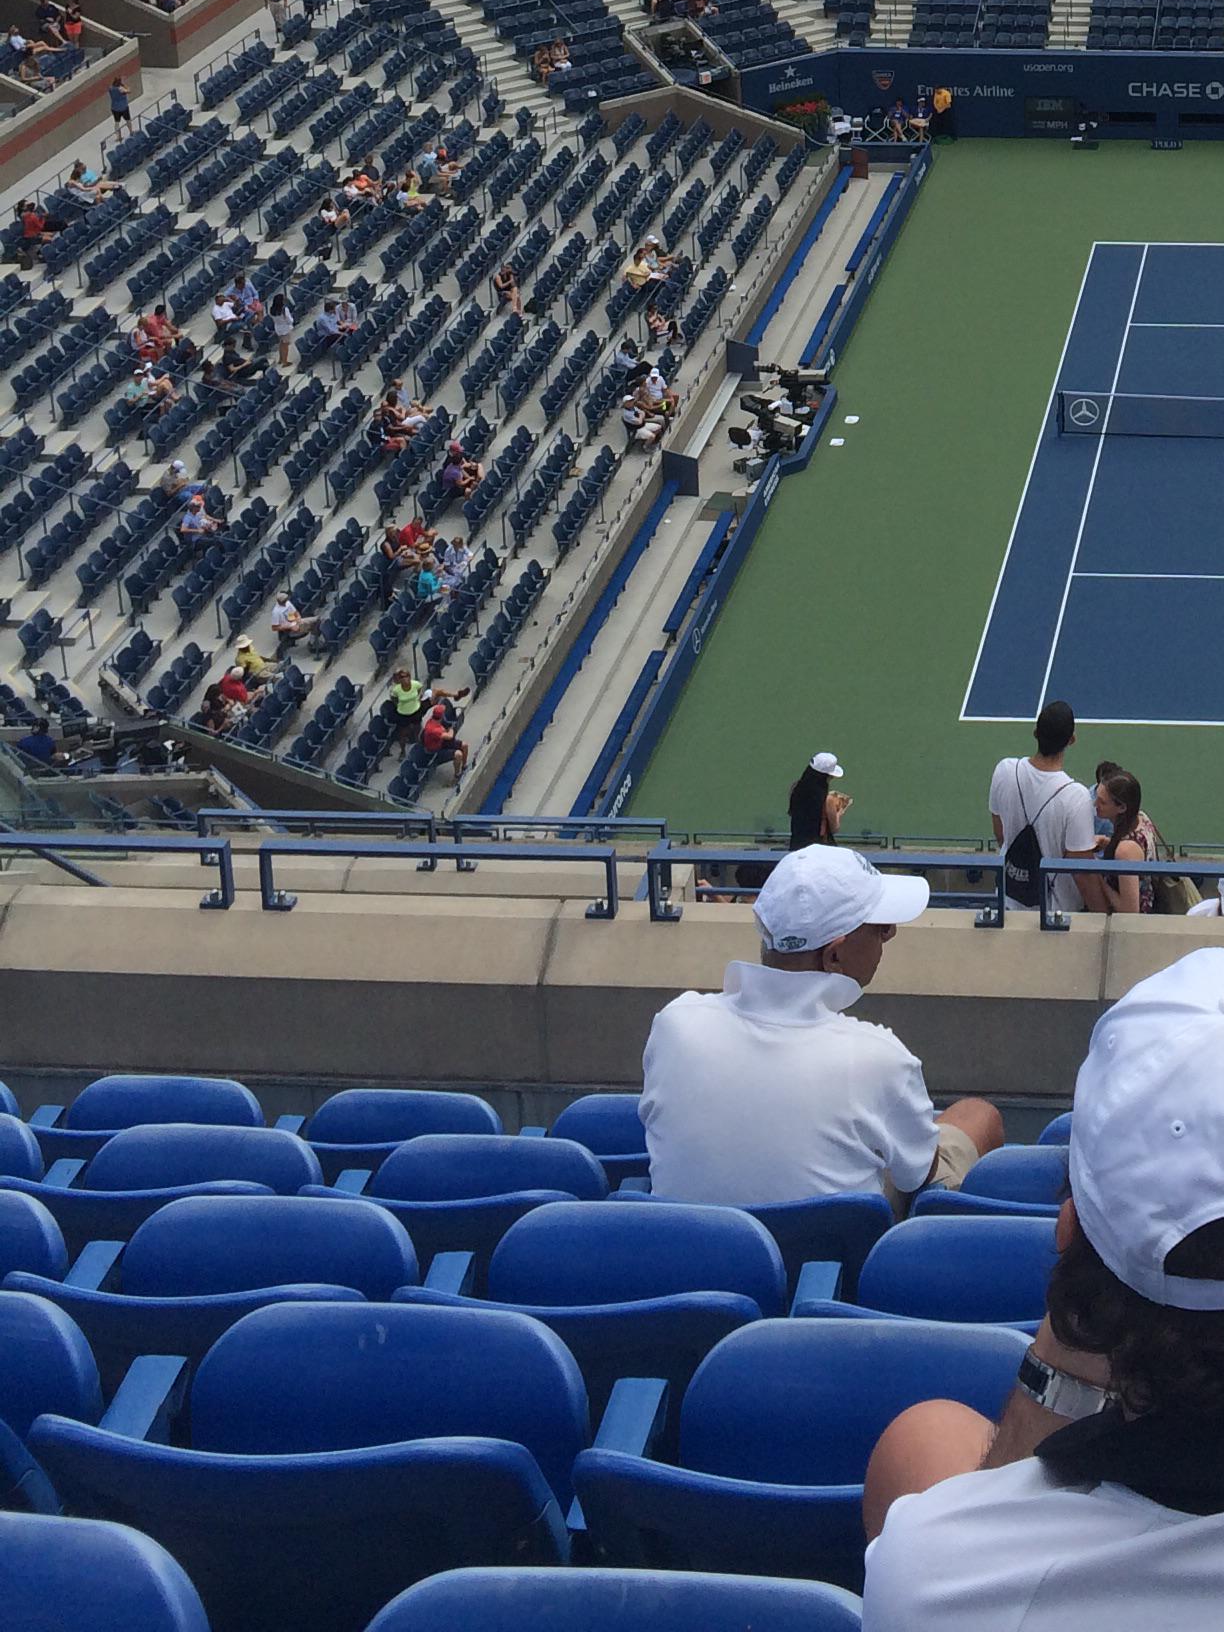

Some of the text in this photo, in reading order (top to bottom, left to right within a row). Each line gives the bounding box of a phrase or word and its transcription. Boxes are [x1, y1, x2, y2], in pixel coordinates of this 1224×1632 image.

[1023, 63, 1074, 73] usopen.org
[768, 76, 814, 94] Heineken
[917, 84, 1016, 97] Emtes Airline
[1128, 82, 1202, 98] CHASE
